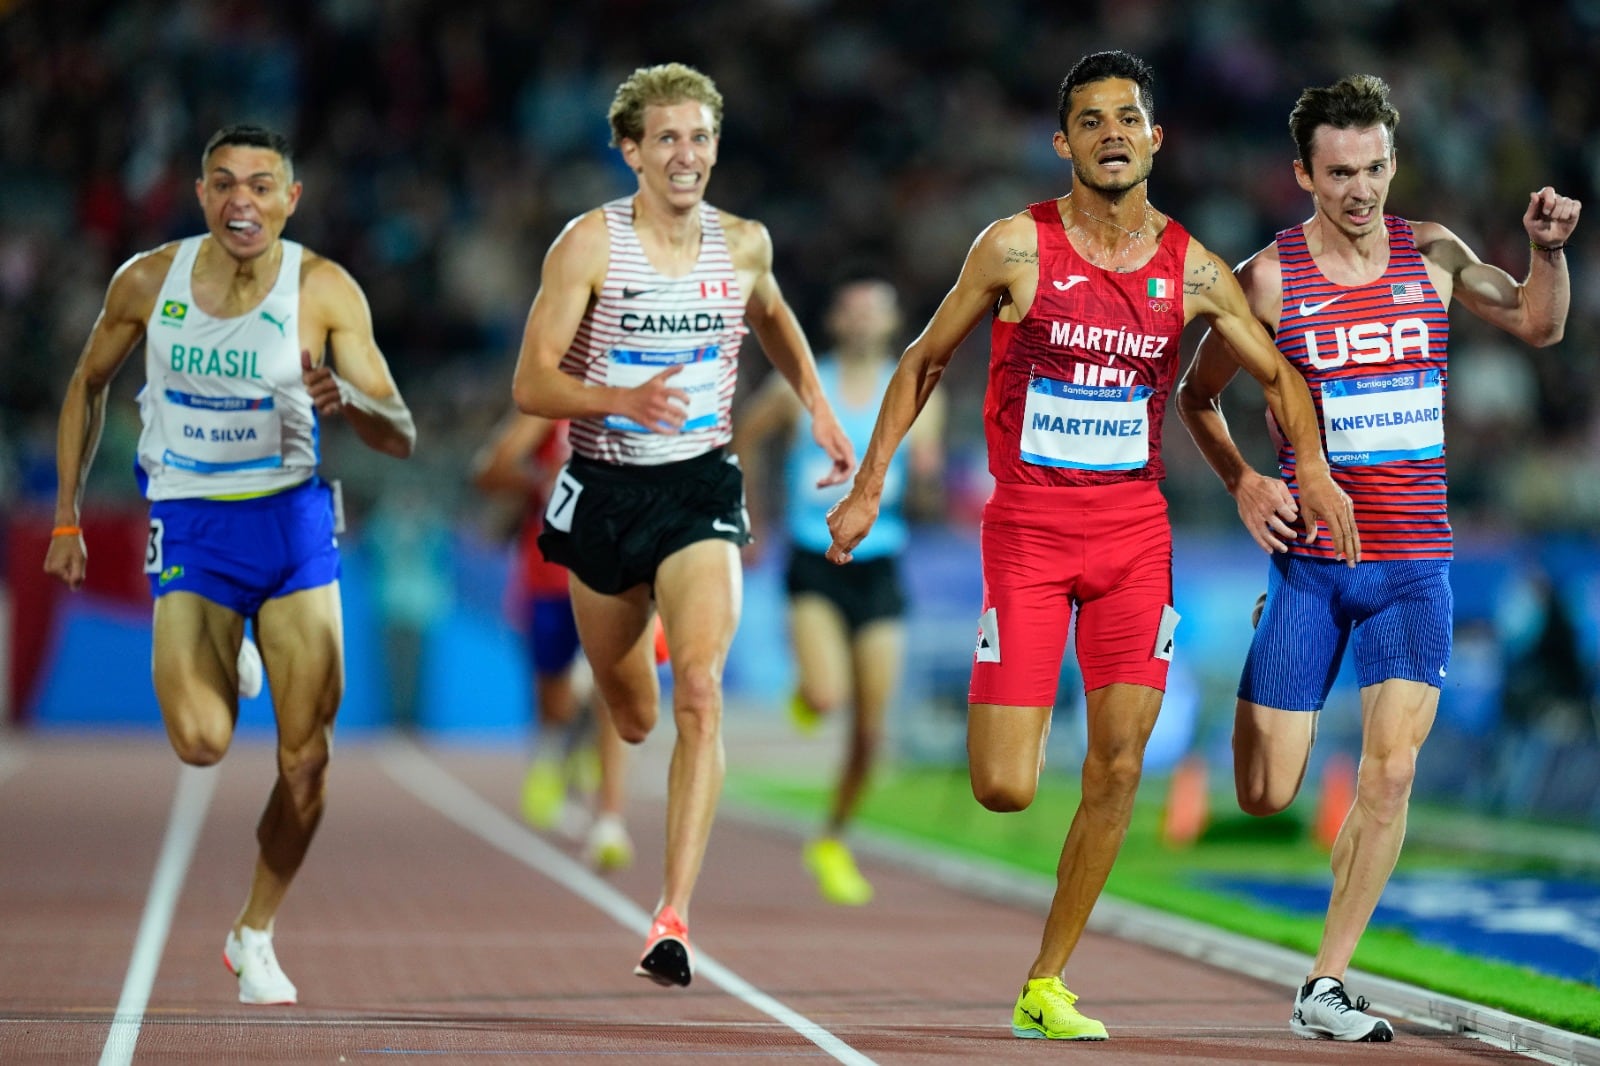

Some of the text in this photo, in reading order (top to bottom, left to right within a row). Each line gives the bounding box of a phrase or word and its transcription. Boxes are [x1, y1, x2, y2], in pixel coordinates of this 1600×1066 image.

[619, 313, 726, 334] CANADA
[1050, 321, 1169, 359] MARTÍNEZ
[1304, 317, 1430, 370] USA
[170, 344, 263, 380] BRASIL
[183, 424, 258, 442] DA SILVA
[1031, 412, 1144, 437] MARTINEZ
[1330, 406, 1440, 432] KNEVELBAARD
[554, 481, 575, 518] 7
[147, 527, 159, 566] 3
